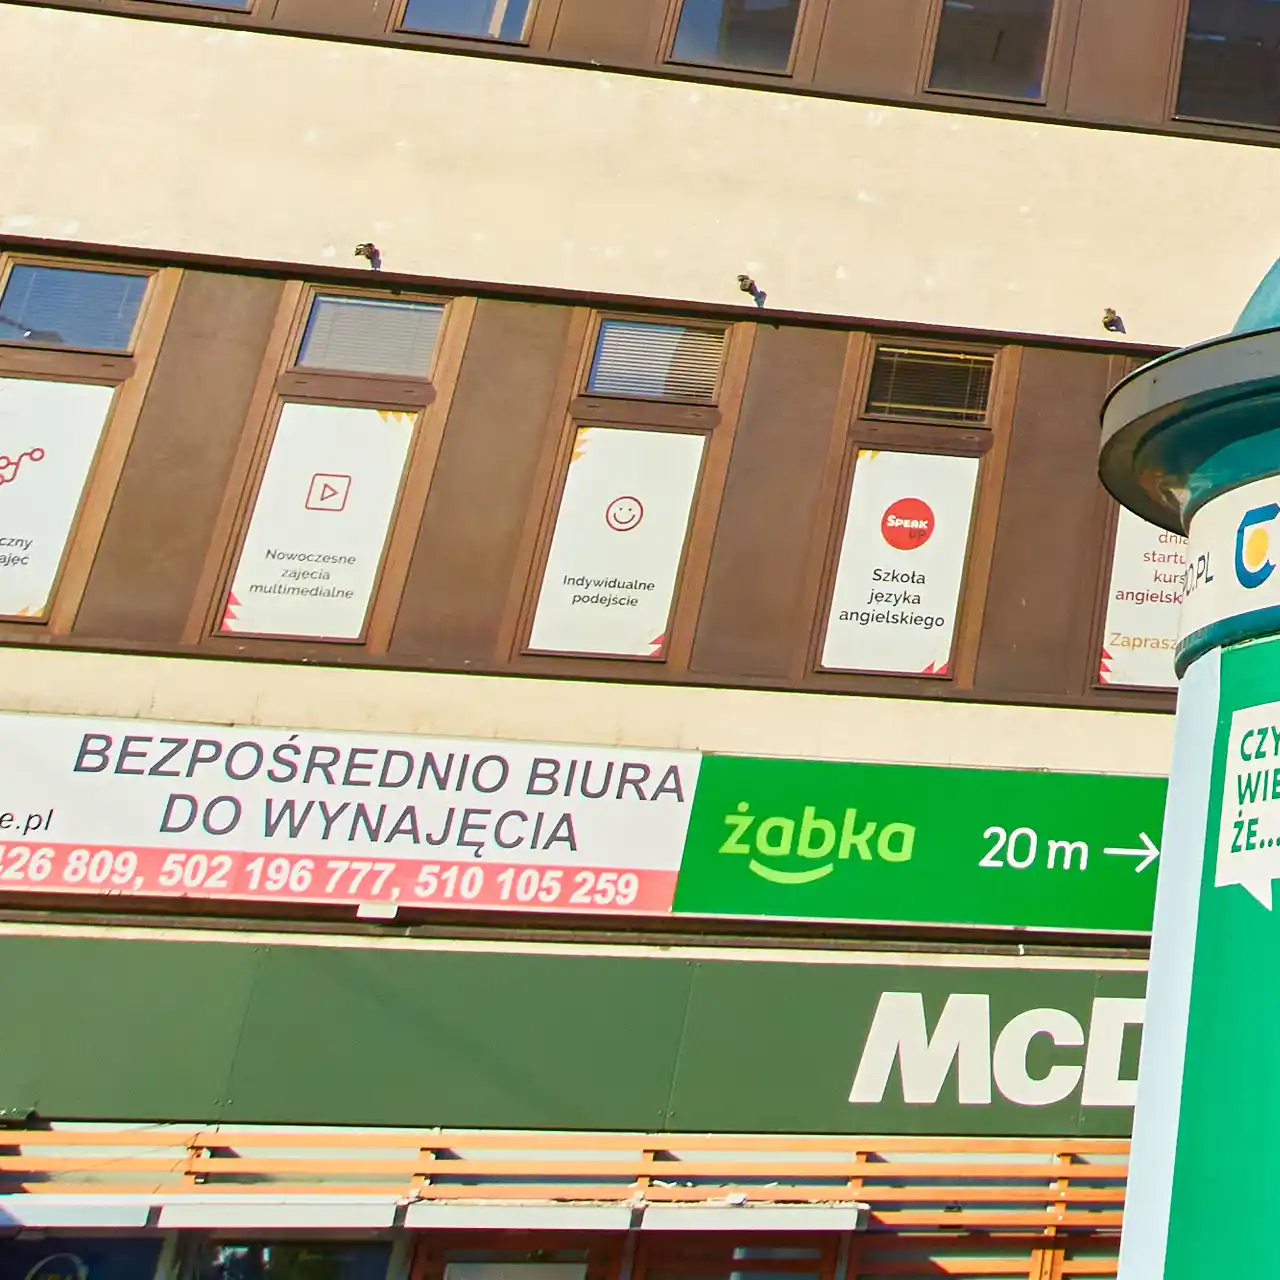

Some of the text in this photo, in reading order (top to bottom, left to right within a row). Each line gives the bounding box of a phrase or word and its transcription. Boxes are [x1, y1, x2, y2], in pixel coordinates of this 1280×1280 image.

[265, 548, 356, 565] Nowoczesne
[562, 574, 656, 591] Indywidualne
[872, 567, 926, 585] Szkoła
[249, 582, 354, 599] multimedialne
[867, 588, 921, 607] języka
[1115, 588, 1183, 605] angielsk
[839, 609, 945, 630] angielskiego
[73, 733, 684, 802] BEZPOŚREDNIO BIURA
[160, 793, 577, 858] DO WYNAJĘCIA
[719, 801, 916, 862] żabka
[979, 826, 1088, 871] 20 m
[0, 845, 639, 906] 26 809, 502 196 777, 510 105 259
